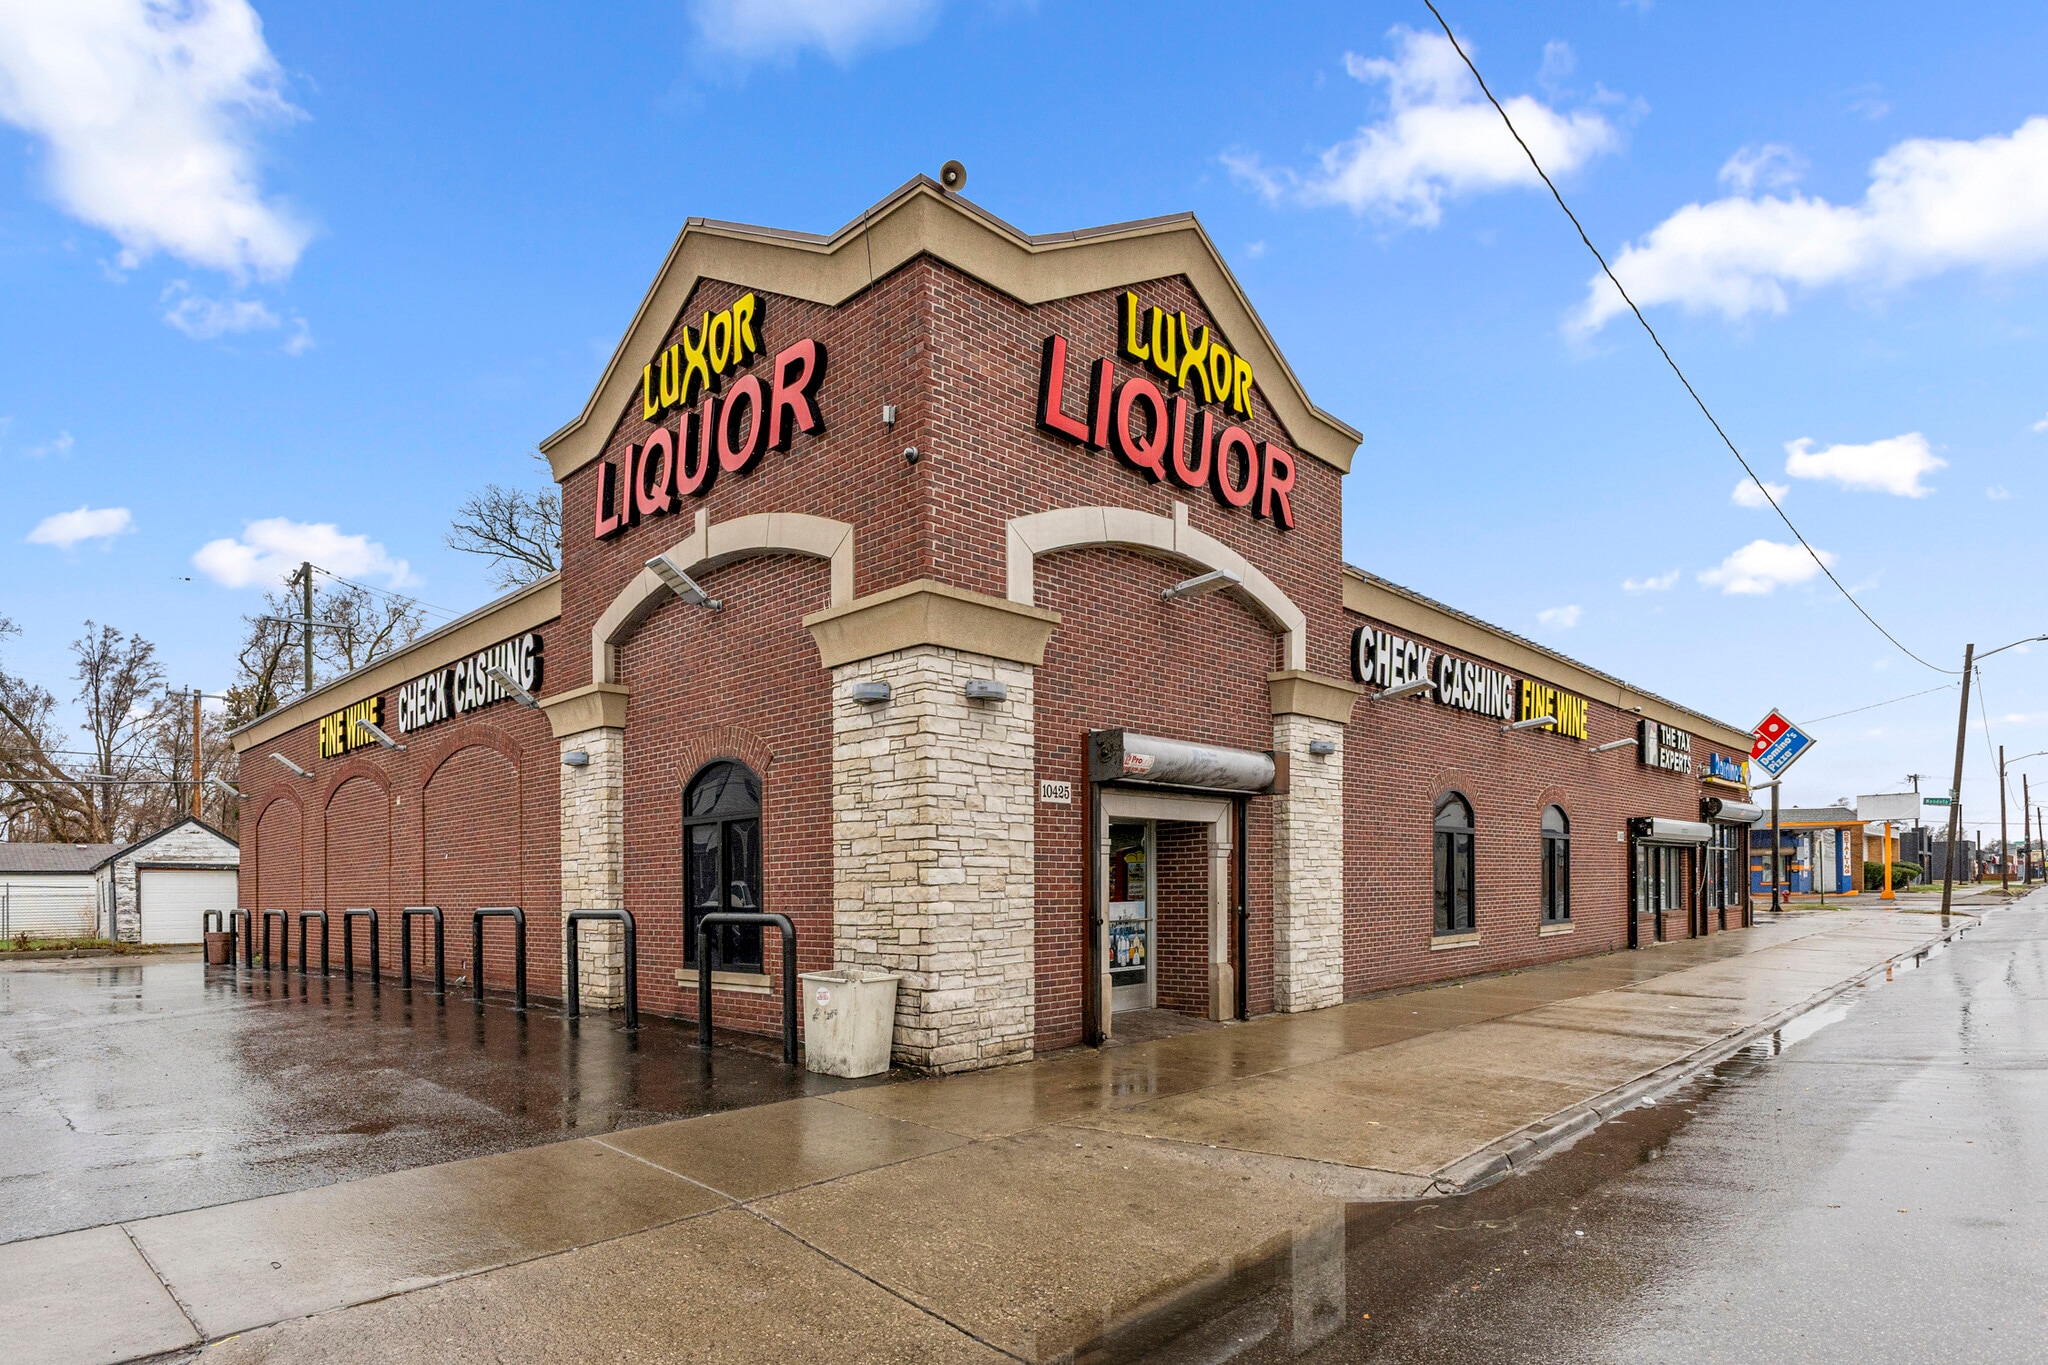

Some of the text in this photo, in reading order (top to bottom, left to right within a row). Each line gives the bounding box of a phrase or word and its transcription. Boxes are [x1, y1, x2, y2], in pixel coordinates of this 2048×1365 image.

[643, 292, 757, 421] LUXOR
[1125, 290, 1254, 420] LUXOR
[594, 338, 818, 539] LIQUOR
[1043, 333, 1296, 530] LIQUOR
[398, 633, 535, 734] CHECK CASHING
[1358, 625, 1513, 720] CHECK CASHING
[319, 696, 378, 759] FINE WINE
[1522, 679, 1589, 740] FINE WINE
[1660, 724, 1691, 753] THE TAX
[1660, 747, 1692, 775] EXPERTS
[1760, 732, 1798, 766] Domino's
[1767, 749, 1793, 772] Pizza
[1042, 784, 1070, 800] 10425
